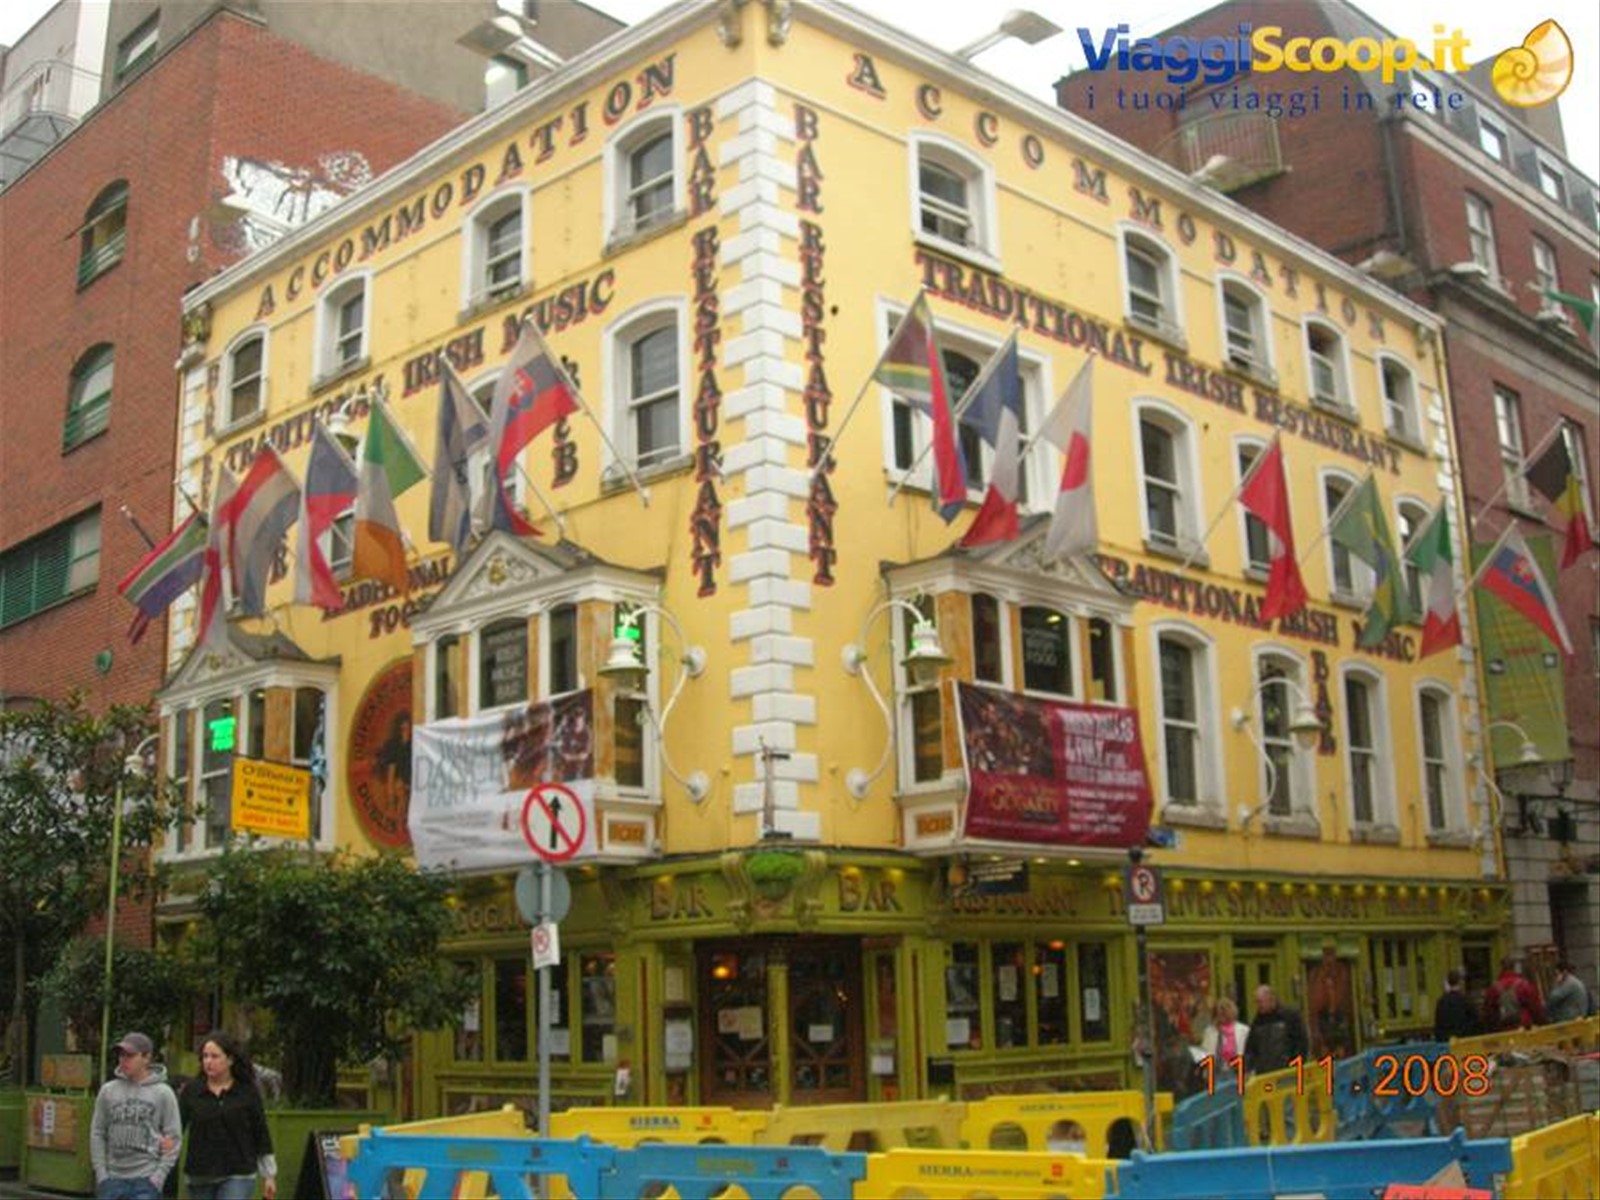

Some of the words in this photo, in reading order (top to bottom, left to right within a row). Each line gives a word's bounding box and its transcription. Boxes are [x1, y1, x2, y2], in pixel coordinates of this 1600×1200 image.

[255, 53, 678, 320] ACCOMMODATION
[686, 106, 714, 218] BAR
[793, 103, 823, 214] BAR
[848, 53, 1389, 343] ACCOMMODATION
[402, 326, 486, 398] IRISH
[500, 268, 615, 355] MUSIC
[689, 224, 723, 598] RESTAURANT
[798, 219, 838, 587] RESTAURANT
[914, 250, 1153, 375] TRADITIONAL
[1165, 352, 1251, 417] IRISH
[1253, 389, 1402, 475] RESTAURANT
[651, 878, 714, 921] BAR
[838, 872, 900, 913] BAR
